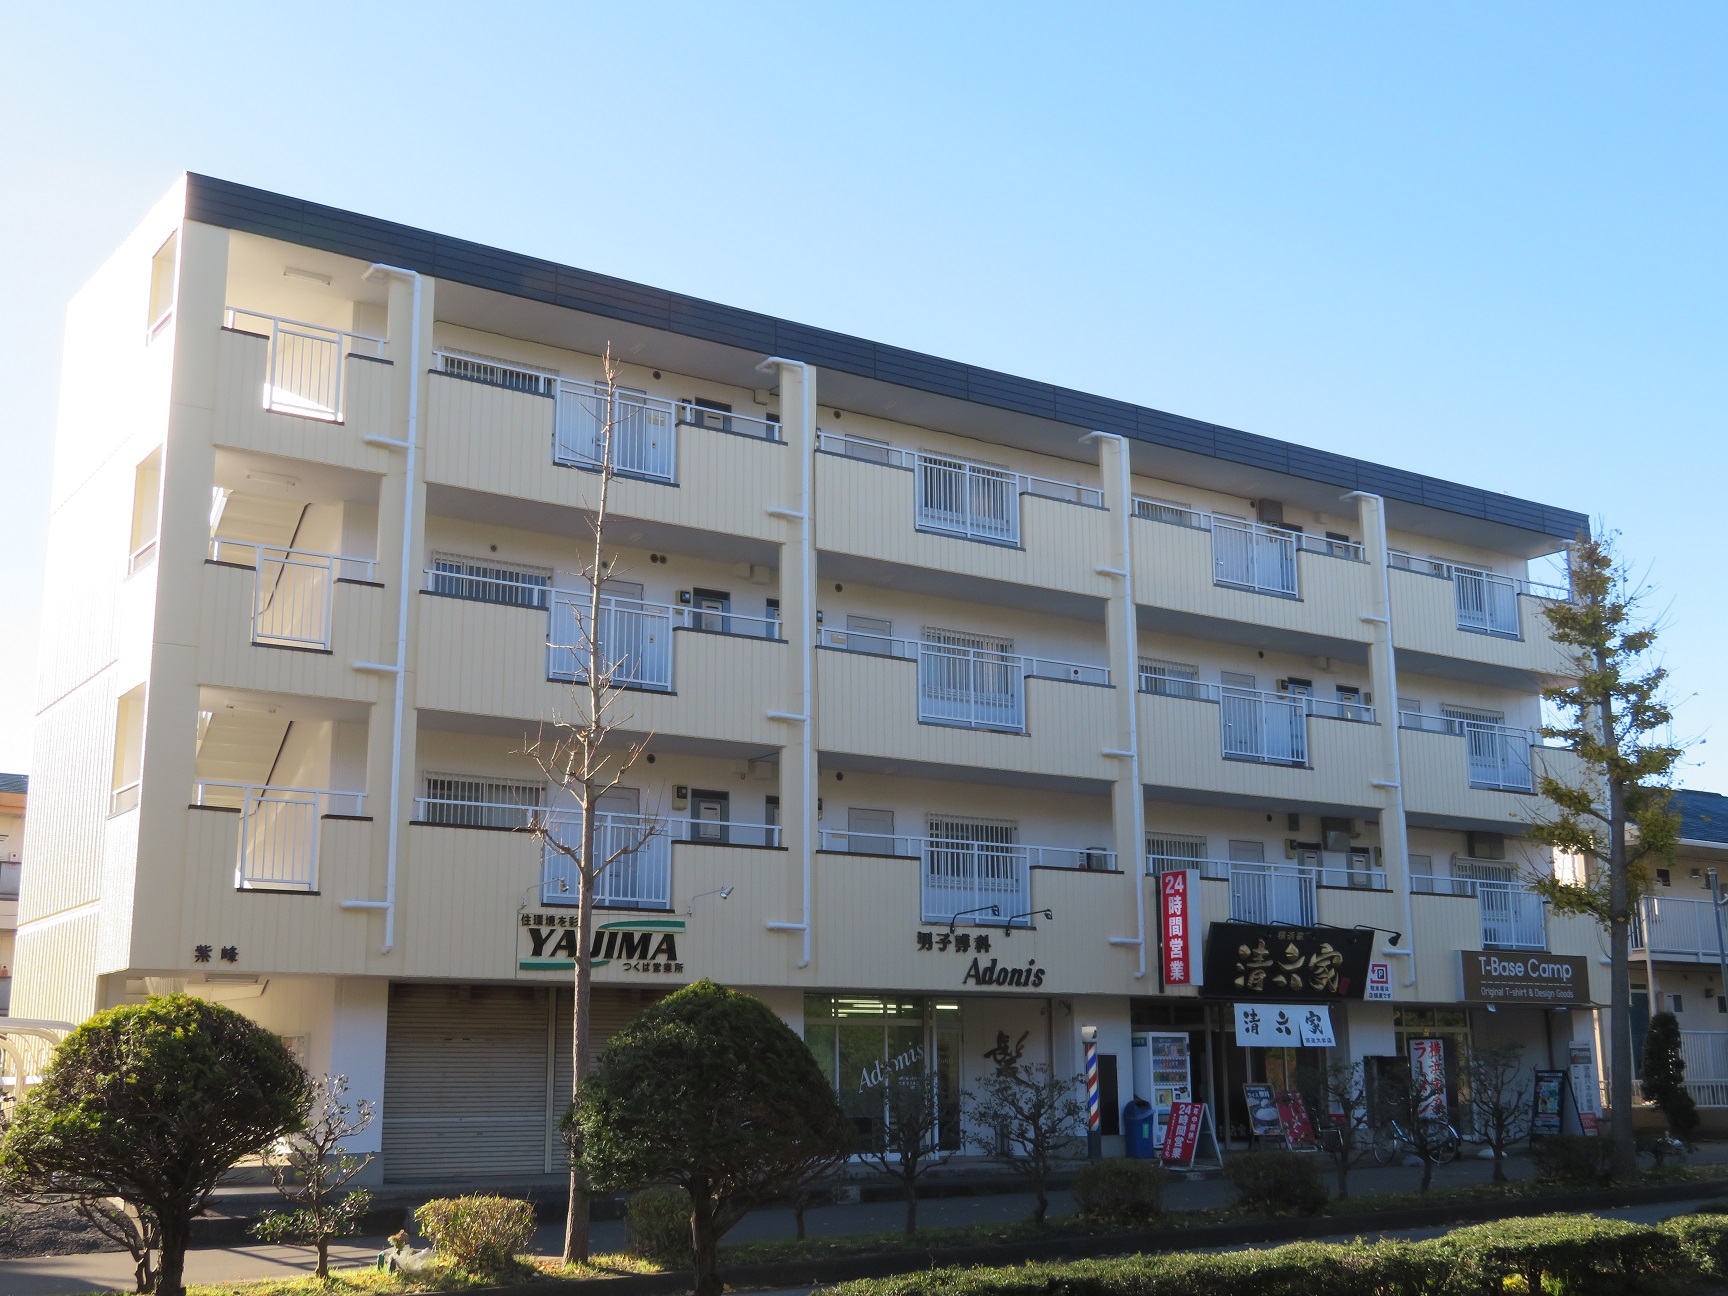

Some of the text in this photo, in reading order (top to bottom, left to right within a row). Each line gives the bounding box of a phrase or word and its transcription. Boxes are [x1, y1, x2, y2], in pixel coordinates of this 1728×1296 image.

[1164, 874, 1185, 981] 24時間営業
[528, 927, 678, 962] YAJIMA
[622, 962, 684, 974] つくば営業所
[962, 956, 1046, 988] Adonis
[1234, 938, 1344, 994] 清六家
[1478, 956, 1572, 982] T-Base Camp
[1480, 987, 1574, 1000] Original T-shirt & Design Goods
[1243, 1008, 1323, 1035] 清六家
[1171, 1104, 1192, 1159] 24時間営業
